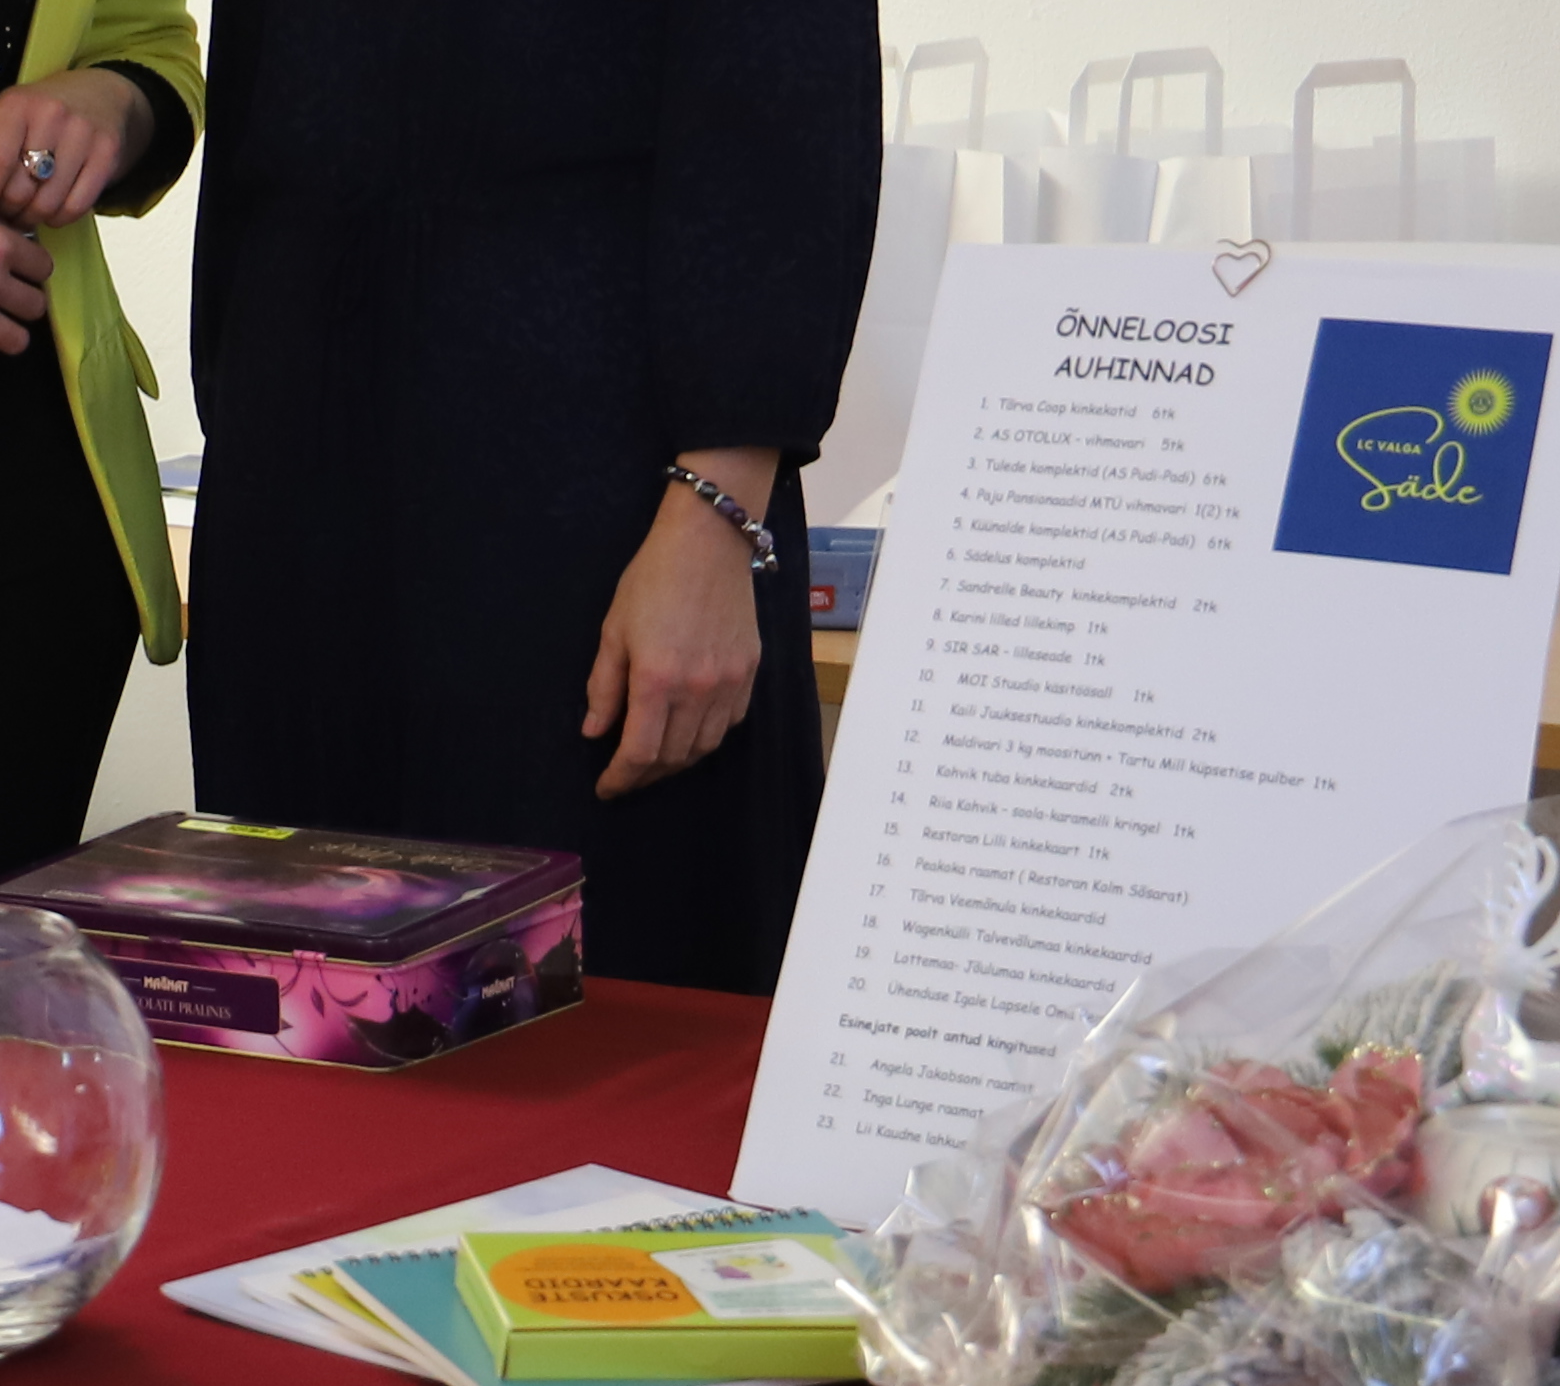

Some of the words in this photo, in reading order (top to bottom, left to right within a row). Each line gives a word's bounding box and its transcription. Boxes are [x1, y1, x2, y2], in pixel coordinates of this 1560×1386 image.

[1054, 307, 1234, 346] ÕNNELOOSI
[1053, 355, 1216, 387] AUHINNAD
[1036, 399, 1067, 416] Coop
[1151, 406, 1175, 420] 6tk
[990, 428, 1010, 441] AS
[1013, 428, 1071, 445] OTOLUX
[1084, 434, 1145, 449] vihmavari
[1160, 437, 1184, 451] 5tk
[1356, 438, 1374, 452] LC
[1377, 439, 1422, 456] VALGA
[985, 457, 1026, 473] Tulede
[1029, 461, 1100, 478] komplektid
[1101, 465, 1127, 480] (AS
[1129, 466, 1196, 486] Pudi-Padi)
[1202, 472, 1226, 486] 6tk
[1335, 405, 1484, 512] Säde
[975, 487, 1004, 506] Paju
[1125, 498, 1186, 514] vihmavari
[1224, 506, 1240, 519] tk
[1028, 522, 1099, 540] komplektid
[1100, 527, 1126, 543] (AS
[1129, 529, 1196, 549] Pudi-Padi)
[1206, 535, 1232, 550] 6tk
[1014, 552, 1086, 570] komplektid
[1019, 583, 1064, 602] Beauty
[1070, 588, 1177, 610] kinkekomplektid
[1192, 598, 1217, 613] 2tk
[949, 610, 986, 624] Karini
[989, 612, 1021, 627] lilled
[1023, 615, 1075, 635] lillekimp
[1087, 620, 1108, 634] 1tk
[942, 640, 968, 654] SIR
[971, 642, 1000, 656] SAR
[1012, 646, 1072, 663] lilleseade
[1083, 651, 1105, 666] 1tk
[991, 675, 1040, 692] Stuudio
[1133, 688, 1154, 703] 1tk
[979, 705, 1072, 727] Juuksestuudio
[1075, 714, 1184, 740] kinkekomplektid
[1191, 727, 1216, 743] 2tk
[1005, 739, 1014, 753] 3
[1017, 740, 1033, 758] kg
[1118, 751, 1155, 769] Tartu
[1158, 757, 1185, 771] Mill
[1257, 771, 1305, 786] pulber
[1313, 775, 1336, 791] 1tk
[935, 764, 977, 780] Kohvik
[981, 770, 1010, 785] tuba
[1012, 772, 1098, 794] kinkekaardid
[1108, 782, 1133, 798] 2tk
[955, 798, 998, 814] Kohvik
[1113, 816, 1161, 837] kringel
[1172, 823, 1195, 839] 1tk
[921, 825, 980, 845] Restoran
[981, 833, 1006, 847] Lilli
[1009, 836, 1080, 856] kinkekaart
[1087, 845, 1109, 860] 1tk
[914, 856, 966, 876] Peakoka
[1027, 869, 1088, 890] Restoran
[1127, 883, 1189, 906] Sõsarat)
[1019, 902, 1106, 926] kinkekaardid
[1064, 940, 1153, 965] kinkekaardid
[963, 959, 1025, 980] Jõulumaa
[1028, 968, 1116, 993] kinkekaardid
[179, 1000, 232, 1020] PRALINES
[989, 995, 1041, 1015] Lapsele
[837, 1012, 900, 1036] Esinejate
[903, 1025, 939, 1040] poolt
[942, 1031, 983, 1047] antud
[985, 1034, 1057, 1058] kingitused
[869, 1058, 913, 1077] Angela
[862, 1088, 893, 1108] Inga
[894, 1094, 934, 1114] Lunge
[855, 1121, 872, 1134] Lii
[875, 1124, 922, 1143] Kaudne
